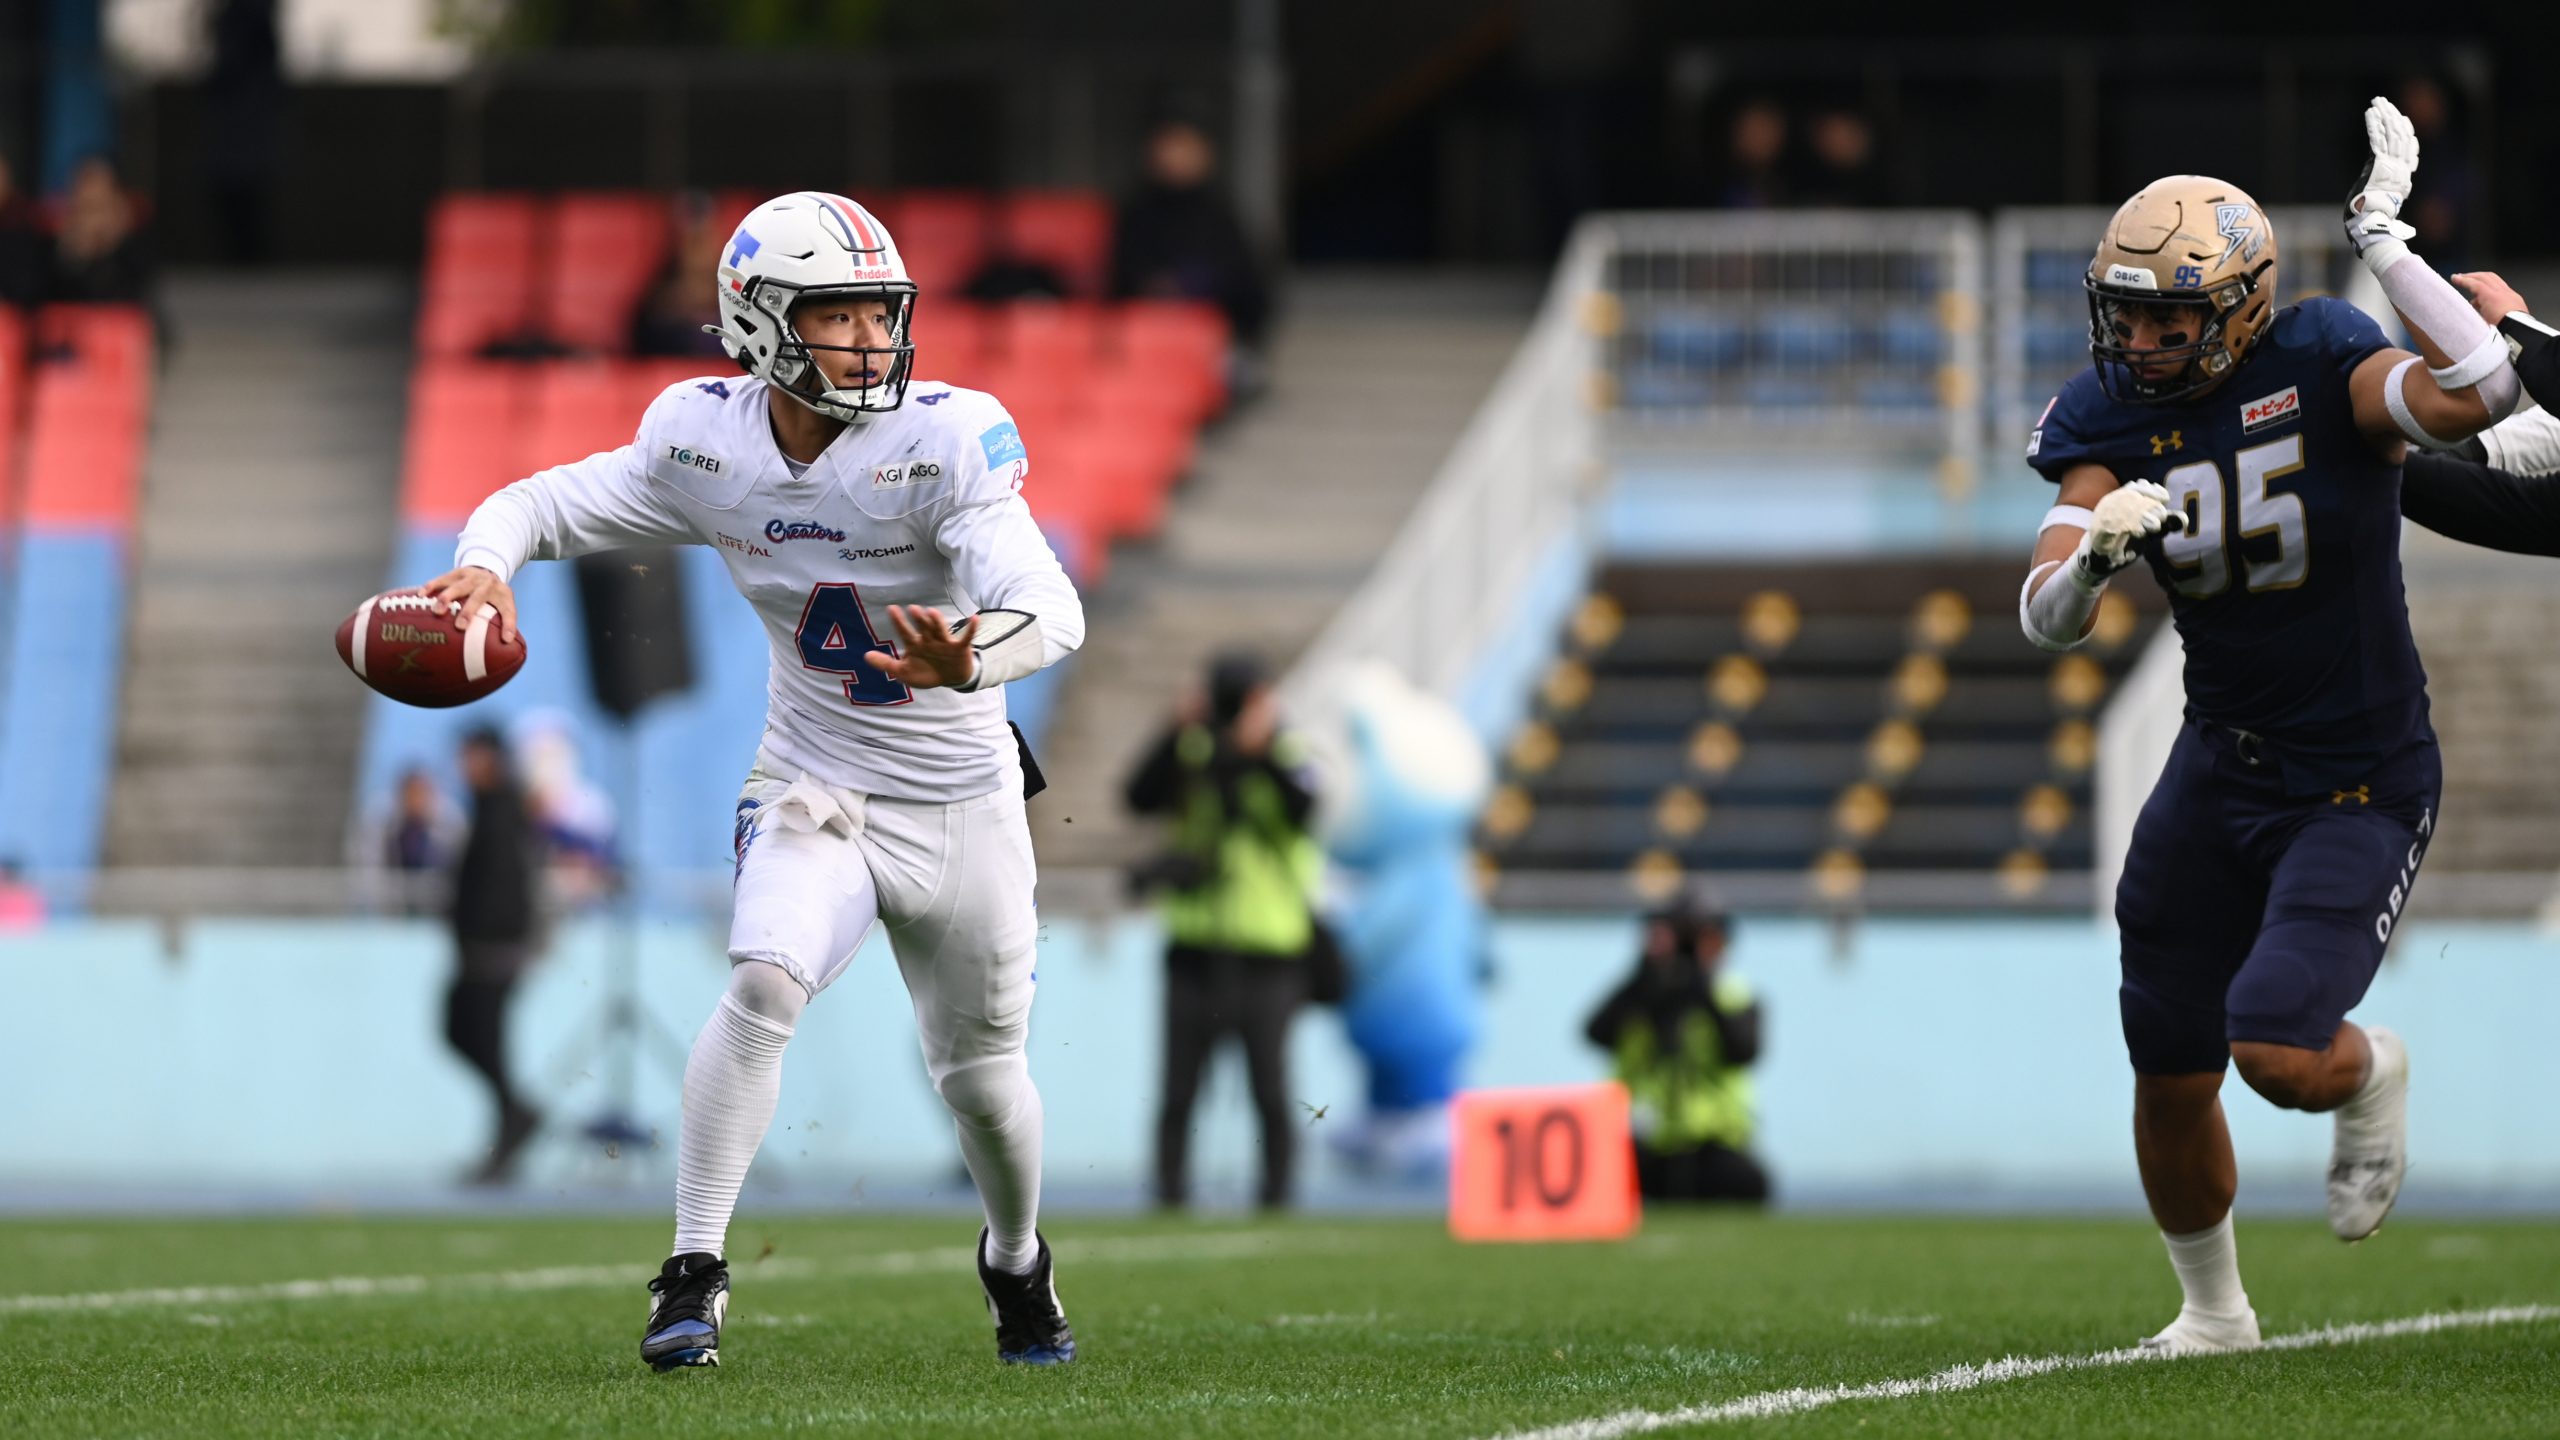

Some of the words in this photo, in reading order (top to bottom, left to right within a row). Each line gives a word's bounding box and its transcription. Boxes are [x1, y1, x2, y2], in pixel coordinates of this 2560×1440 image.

[855, 269, 893, 280] Riddell
[2173, 265, 2203, 288] 95
[694, 381, 731, 401] 4
[914, 391, 952, 407] 4
[2245, 392, 2296, 423] オービック
[2162, 432, 2309, 600] 95
[764, 518, 847, 544] Creators
[855, 544, 915, 558] TACHIHI
[381, 622, 448, 644] Wilson
[795, 581, 914, 707] 4
[1496, 1107, 1585, 1212] 10
